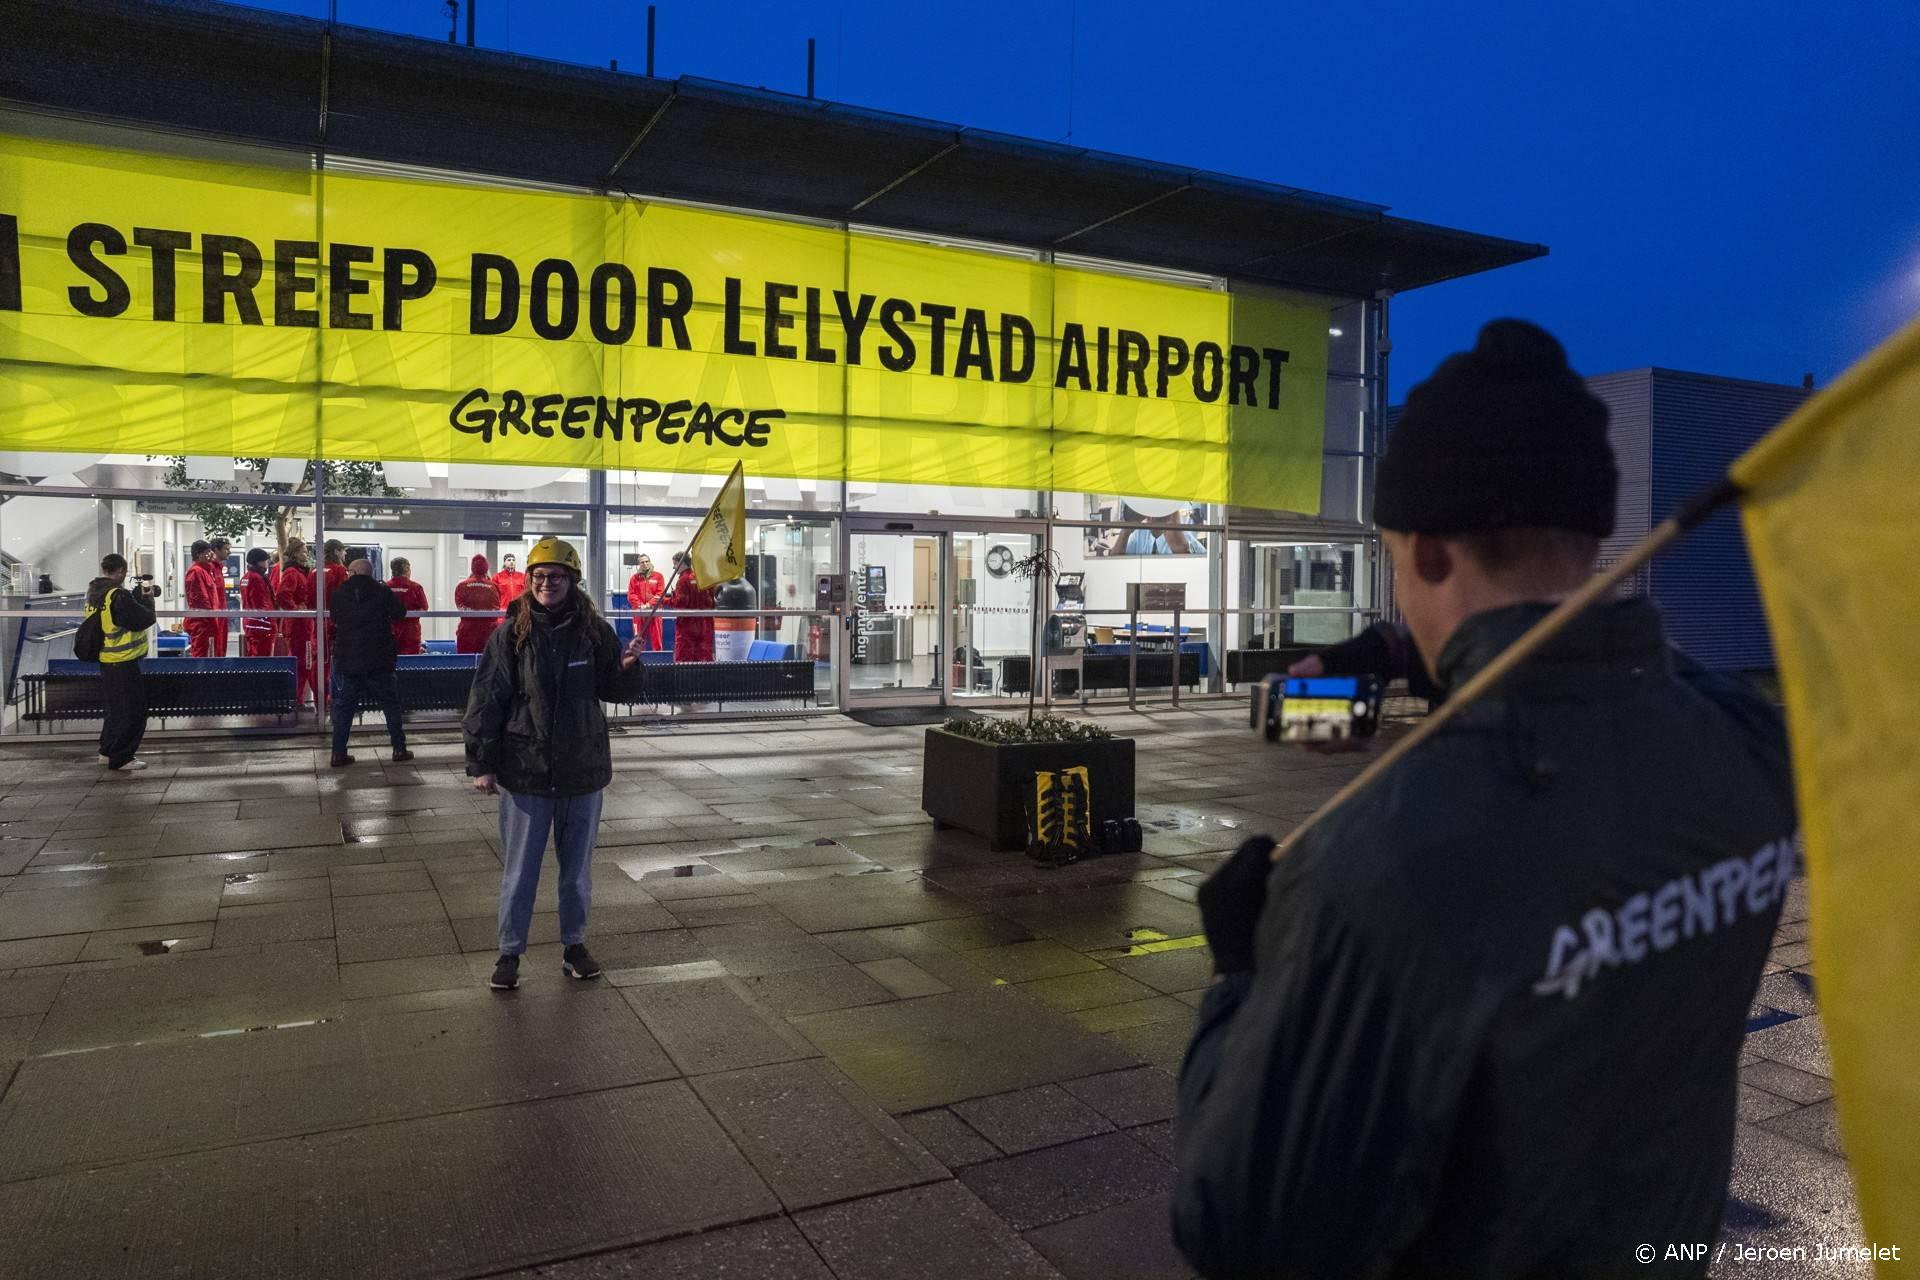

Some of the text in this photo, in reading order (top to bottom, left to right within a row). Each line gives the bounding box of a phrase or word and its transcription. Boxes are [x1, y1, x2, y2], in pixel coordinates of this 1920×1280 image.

[67, 222, 437, 331] STREEP
[470, 253, 693, 351] DOOR
[725, 278, 1036, 383] LELYSTAD
[1055, 322, 1290, 411] AIRPORT
[450, 388, 786, 446] GREENPEACE
